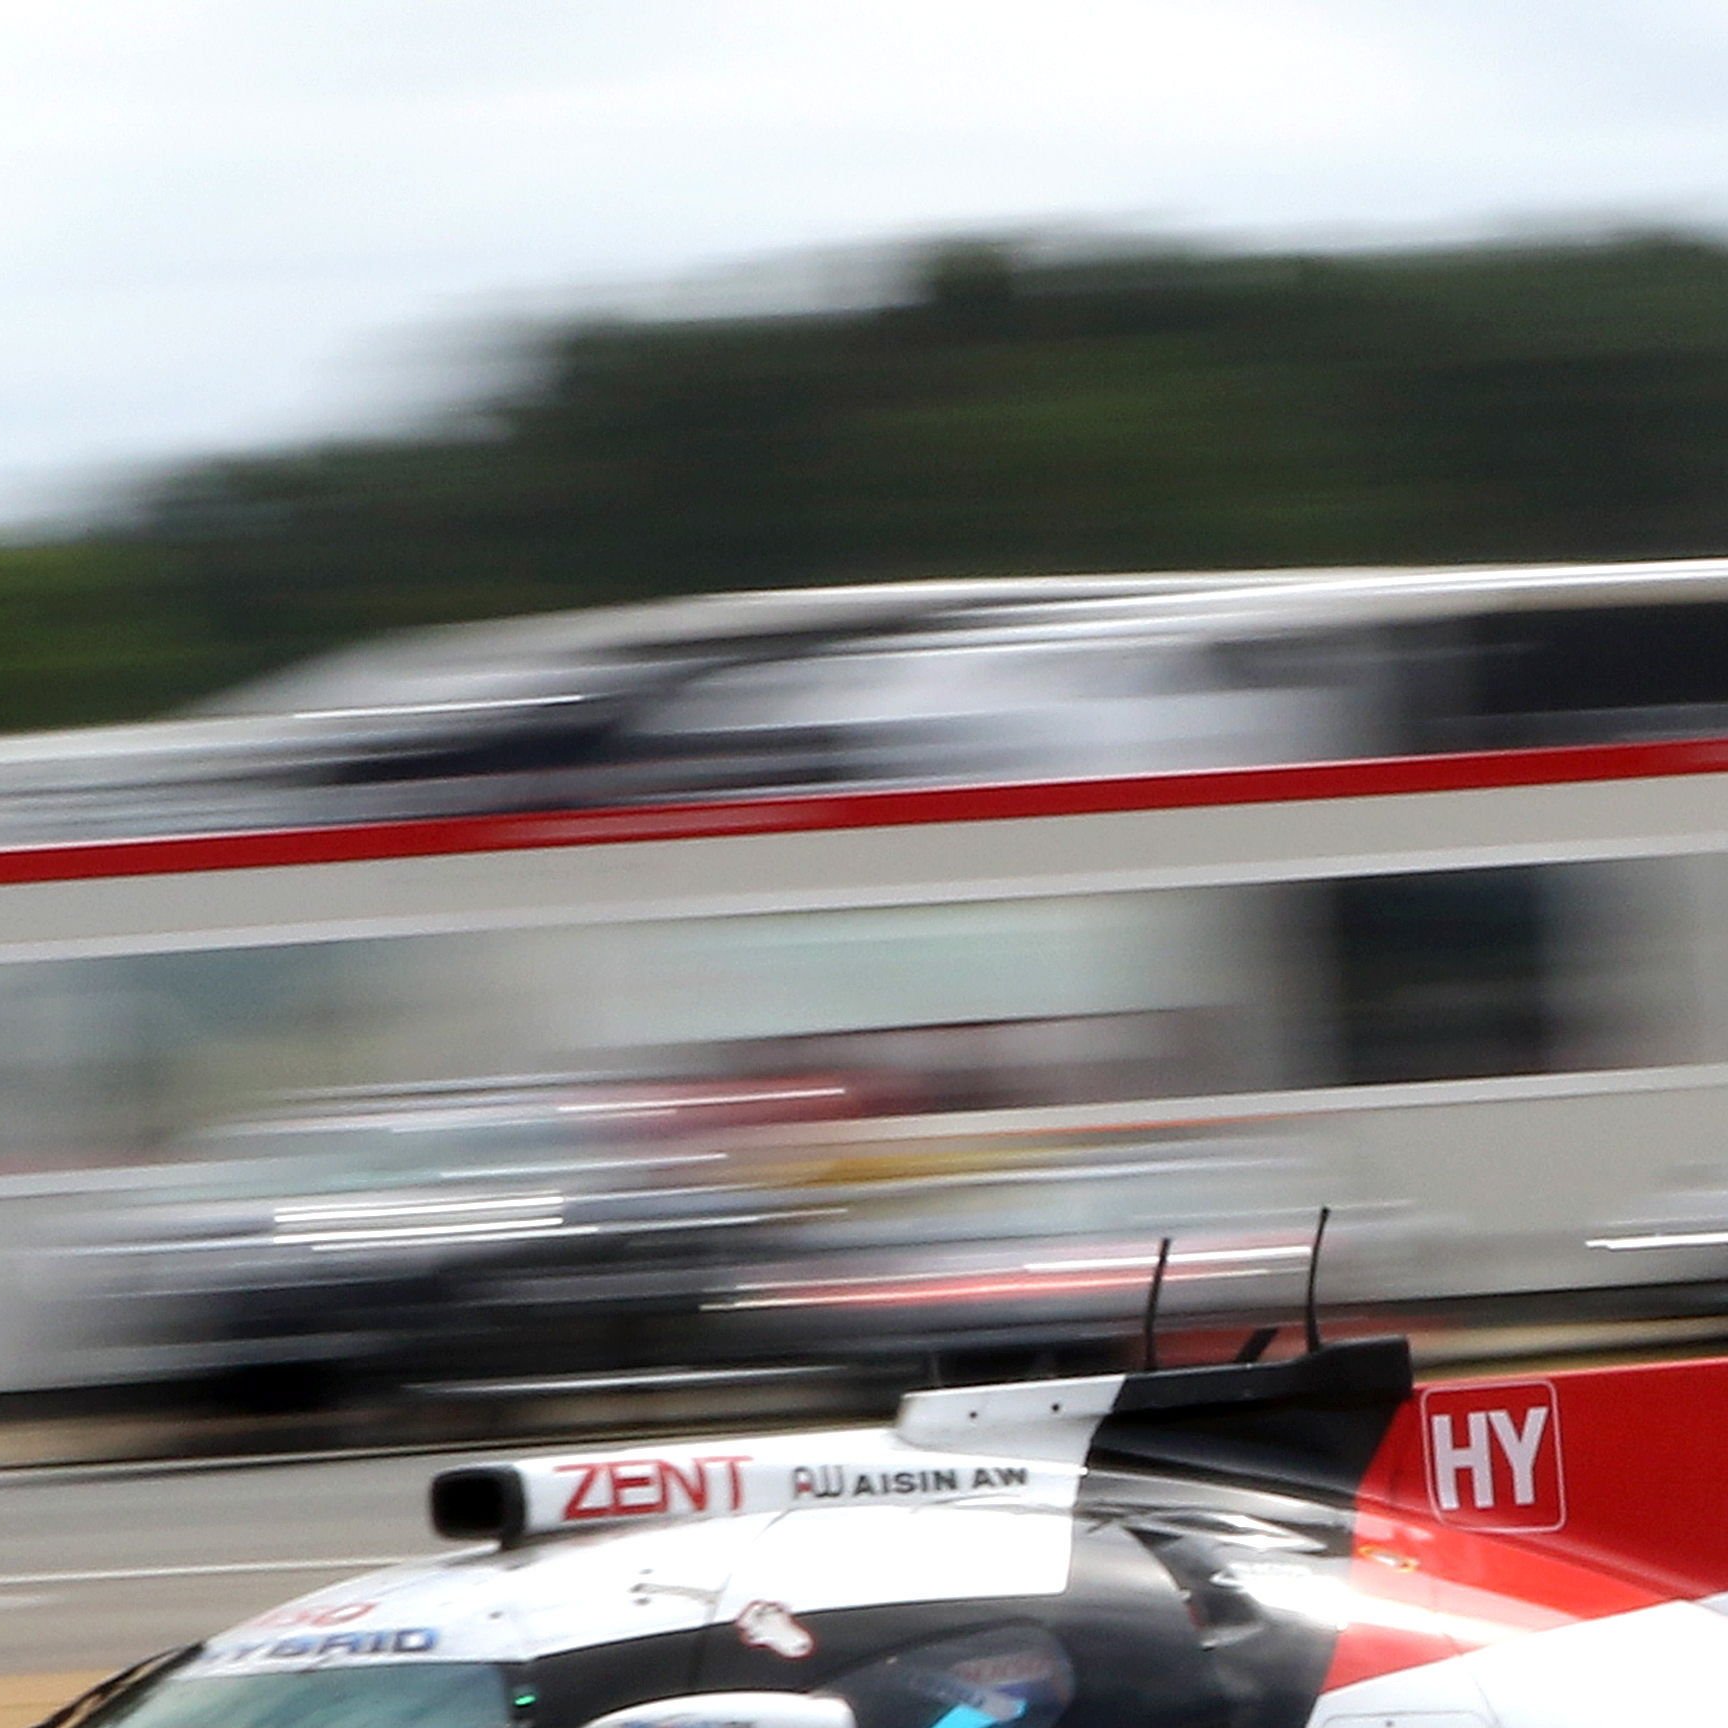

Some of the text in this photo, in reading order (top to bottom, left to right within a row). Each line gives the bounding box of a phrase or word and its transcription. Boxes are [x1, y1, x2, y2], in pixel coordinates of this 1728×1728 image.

[553, 1456, 753, 1520] ZENT
[853, 1468, 957, 1496] AISIN
[972, 1466, 1029, 1489] AW
[1430, 1406, 1549, 1510] HY
